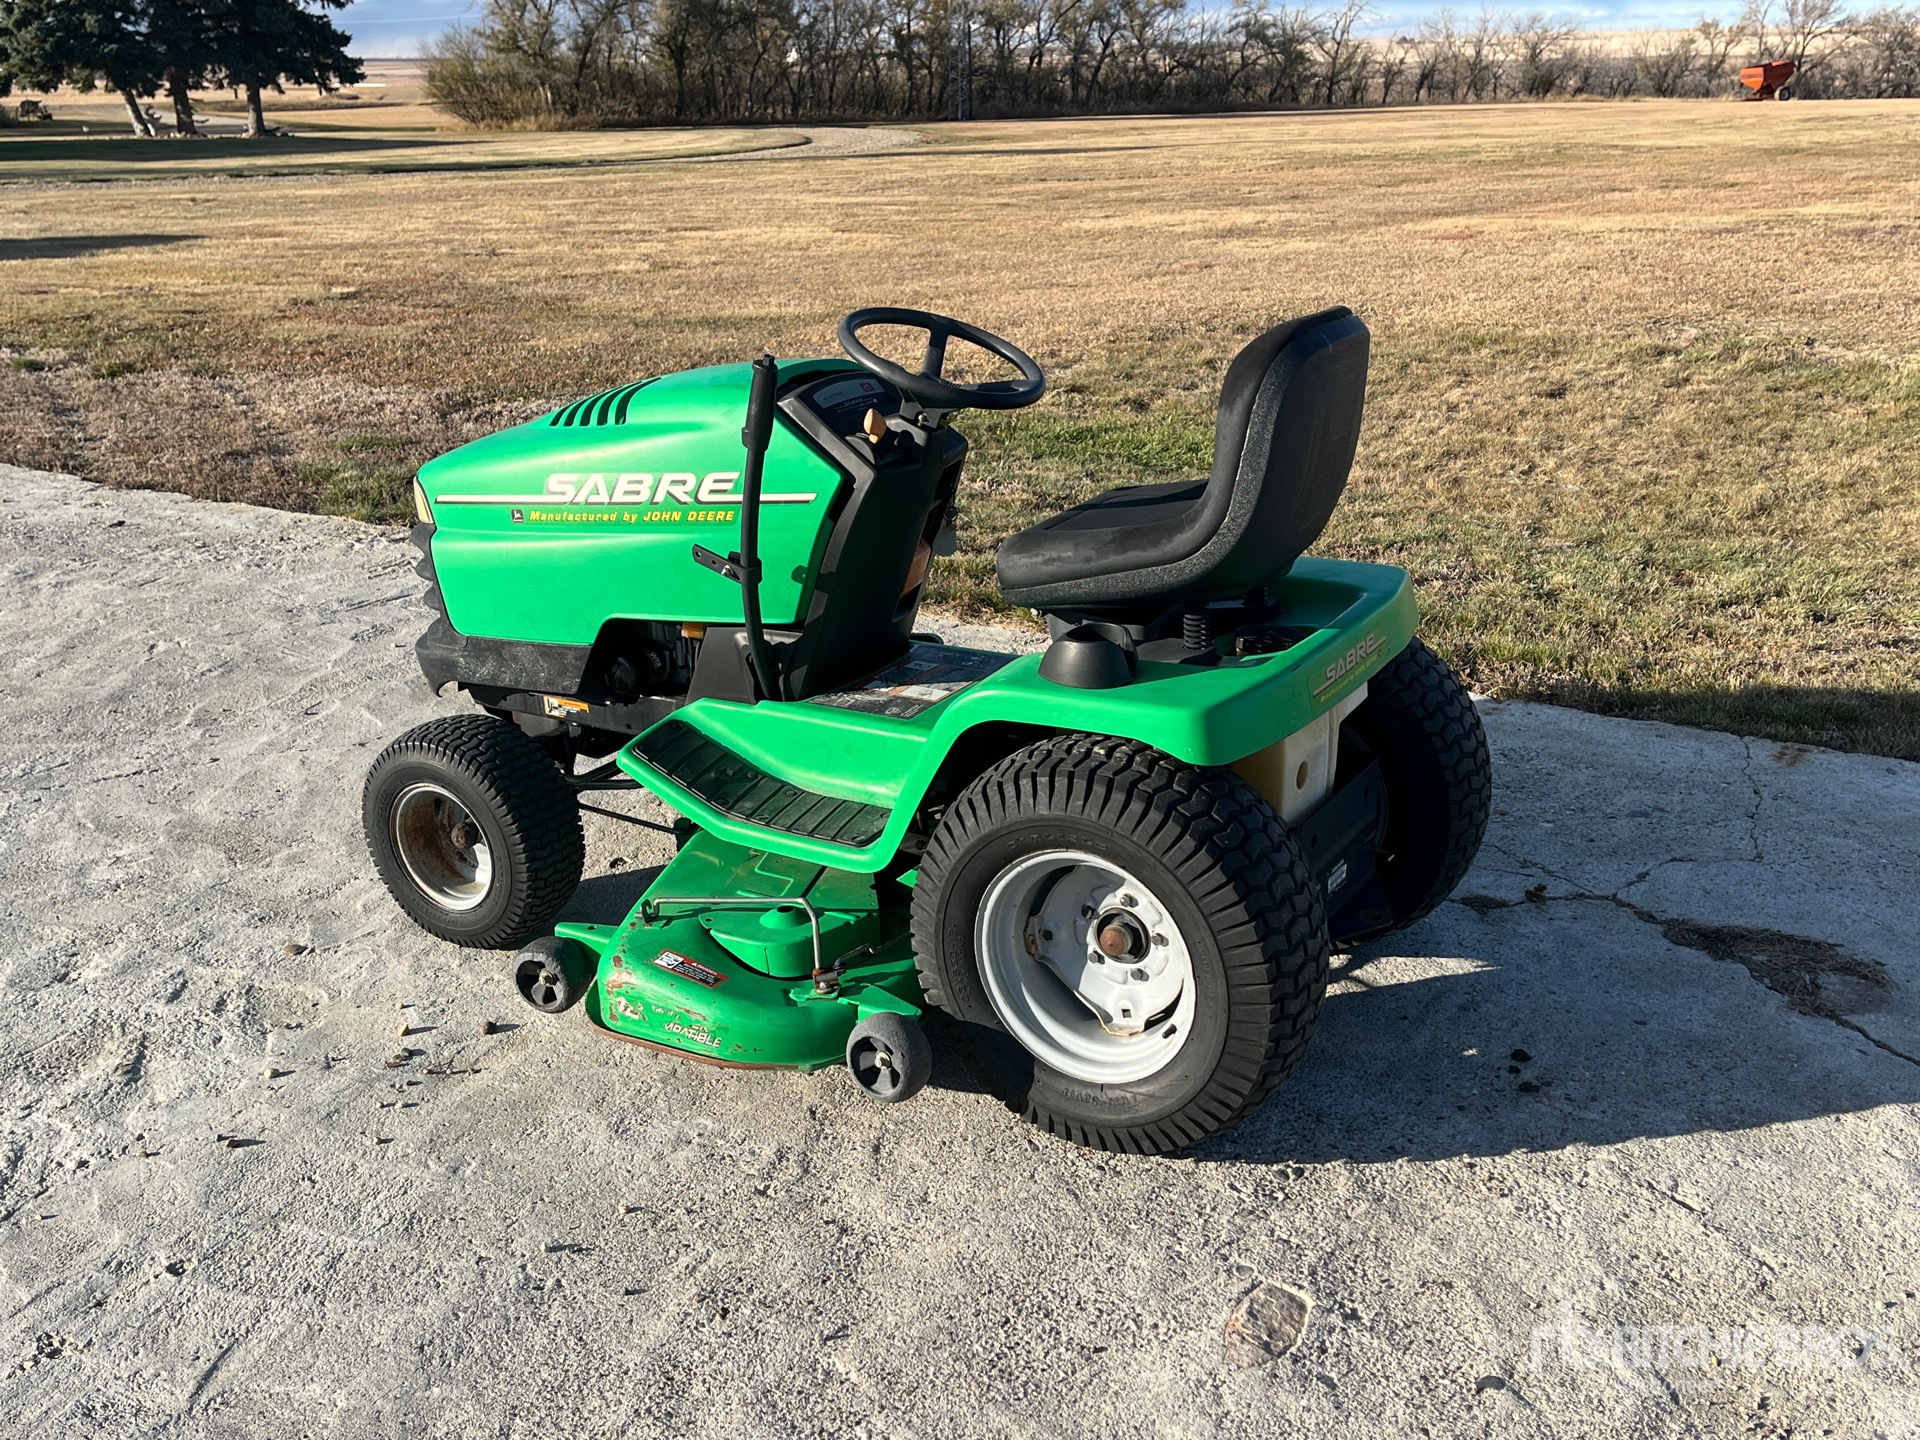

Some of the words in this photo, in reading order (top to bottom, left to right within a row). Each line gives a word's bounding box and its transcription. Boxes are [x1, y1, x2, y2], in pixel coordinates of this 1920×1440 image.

[544, 472, 742, 505] SABRE
[529, 511, 616, 522] Manufactured
[623, 512, 637, 524] by
[643, 511, 681, 522] JOHN
[686, 510, 735, 522] DEERE
[650, 651, 662, 668] WIX
[1325, 633, 1375, 682] SABRE
